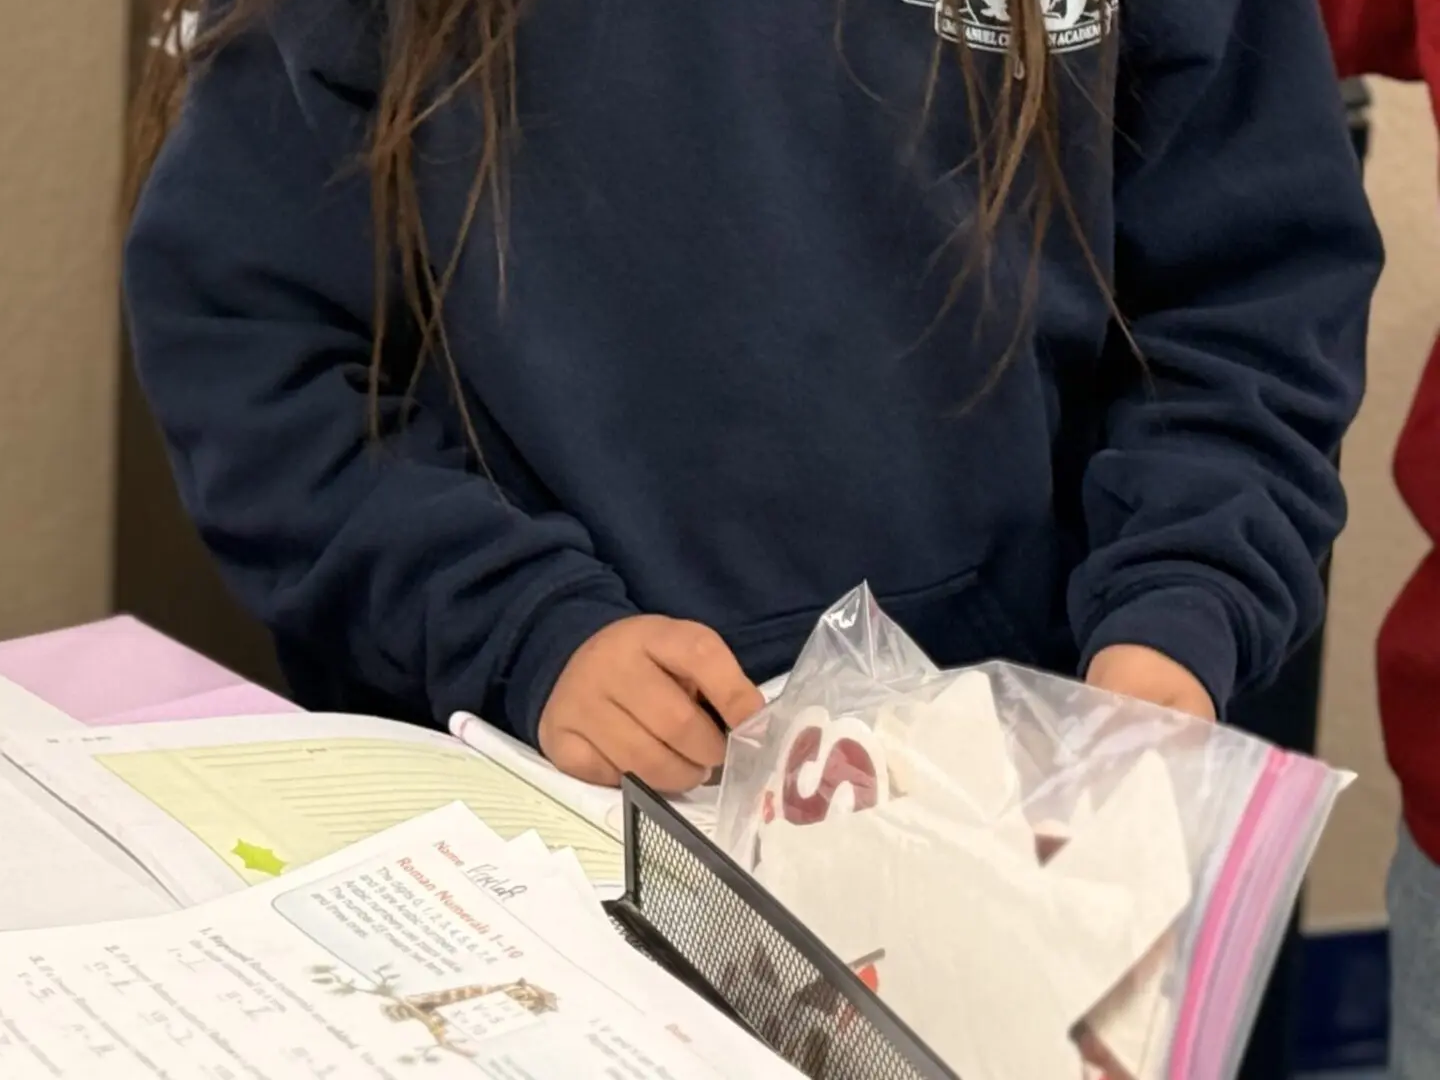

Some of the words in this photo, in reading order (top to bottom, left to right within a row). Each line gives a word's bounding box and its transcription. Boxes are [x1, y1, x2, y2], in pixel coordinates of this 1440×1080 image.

[1057, 24, 1103, 47] ACADEM
[433, 840, 465, 867] Name
[376, 866, 393, 881] The
[328, 885, 346, 902] The
[396, 857, 436, 891] Roman
[434, 890, 490, 935] Numerals
[394, 902, 424, 928] Arabic
